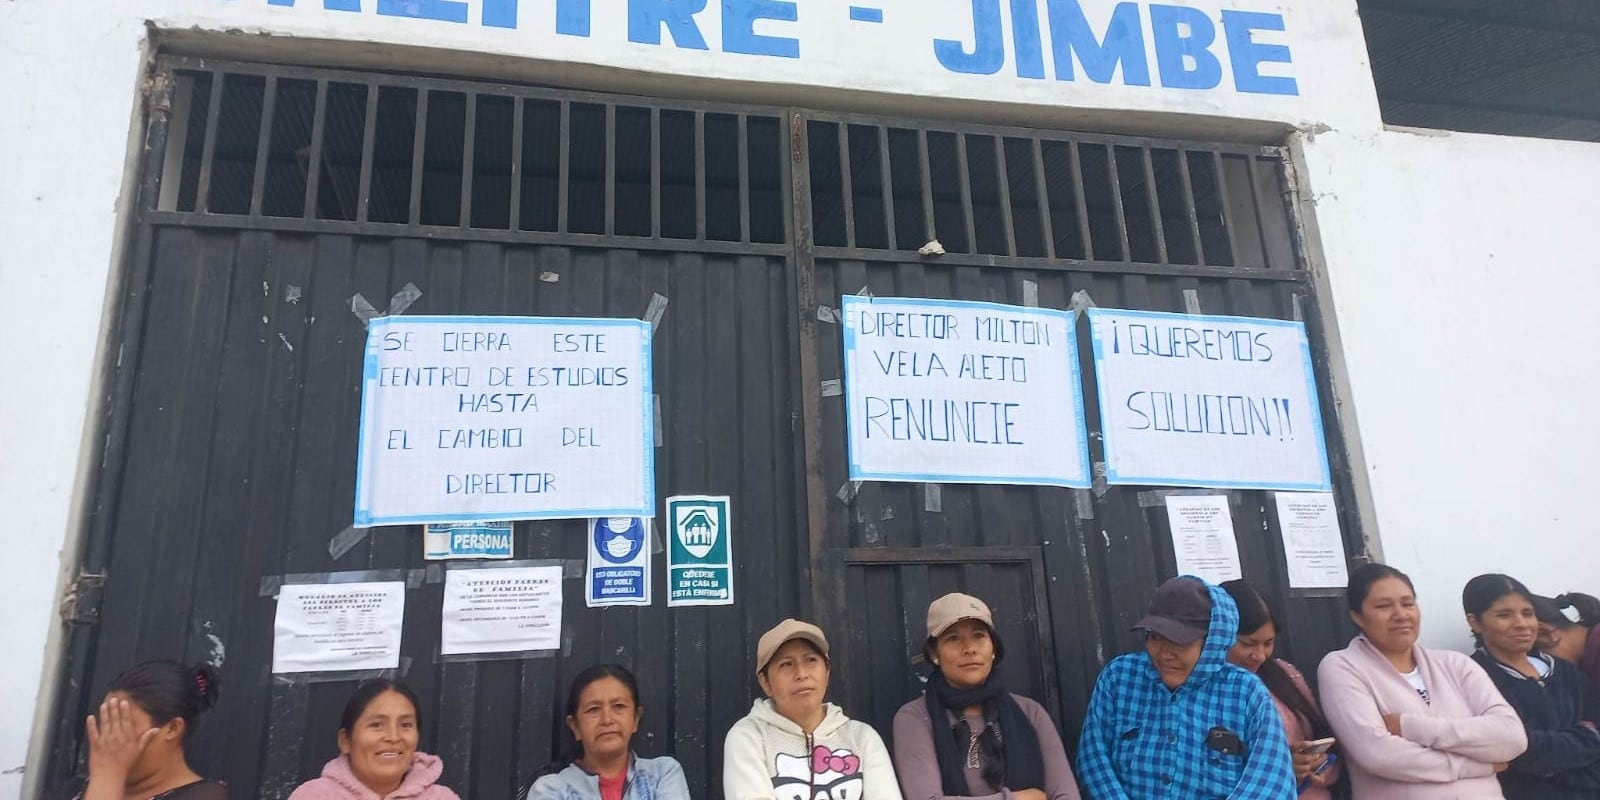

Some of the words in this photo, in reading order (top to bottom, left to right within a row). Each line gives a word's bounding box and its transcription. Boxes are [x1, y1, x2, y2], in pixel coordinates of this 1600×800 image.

[933, 0, 1300, 96] JIMBE
[861, 310, 960, 340] DIRECTOR
[975, 316, 1050, 346] MILTON
[383, 331, 413, 351] SE
[443, 332, 511, 352] CIERRA
[553, 333, 608, 352] ESTE
[379, 366, 471, 387] CENTRO
[488, 366, 514, 387] DE
[527, 366, 629, 387] ESTUDIOS
[873, 350, 949, 378] VELA
[958, 353, 1027, 383] ALEJO
[458, 393, 539, 413] HASTA
[865, 396, 1025, 445] RENUNCIE
[1126, 391, 1295, 442] SOLUCION!!
[387, 429, 413, 450] EL
[438, 427, 523, 449] CAMBIO
[562, 427, 601, 447] DEL
[446, 473, 556, 494] DIRECTOR
[453, 533, 509, 550] PERSONA
